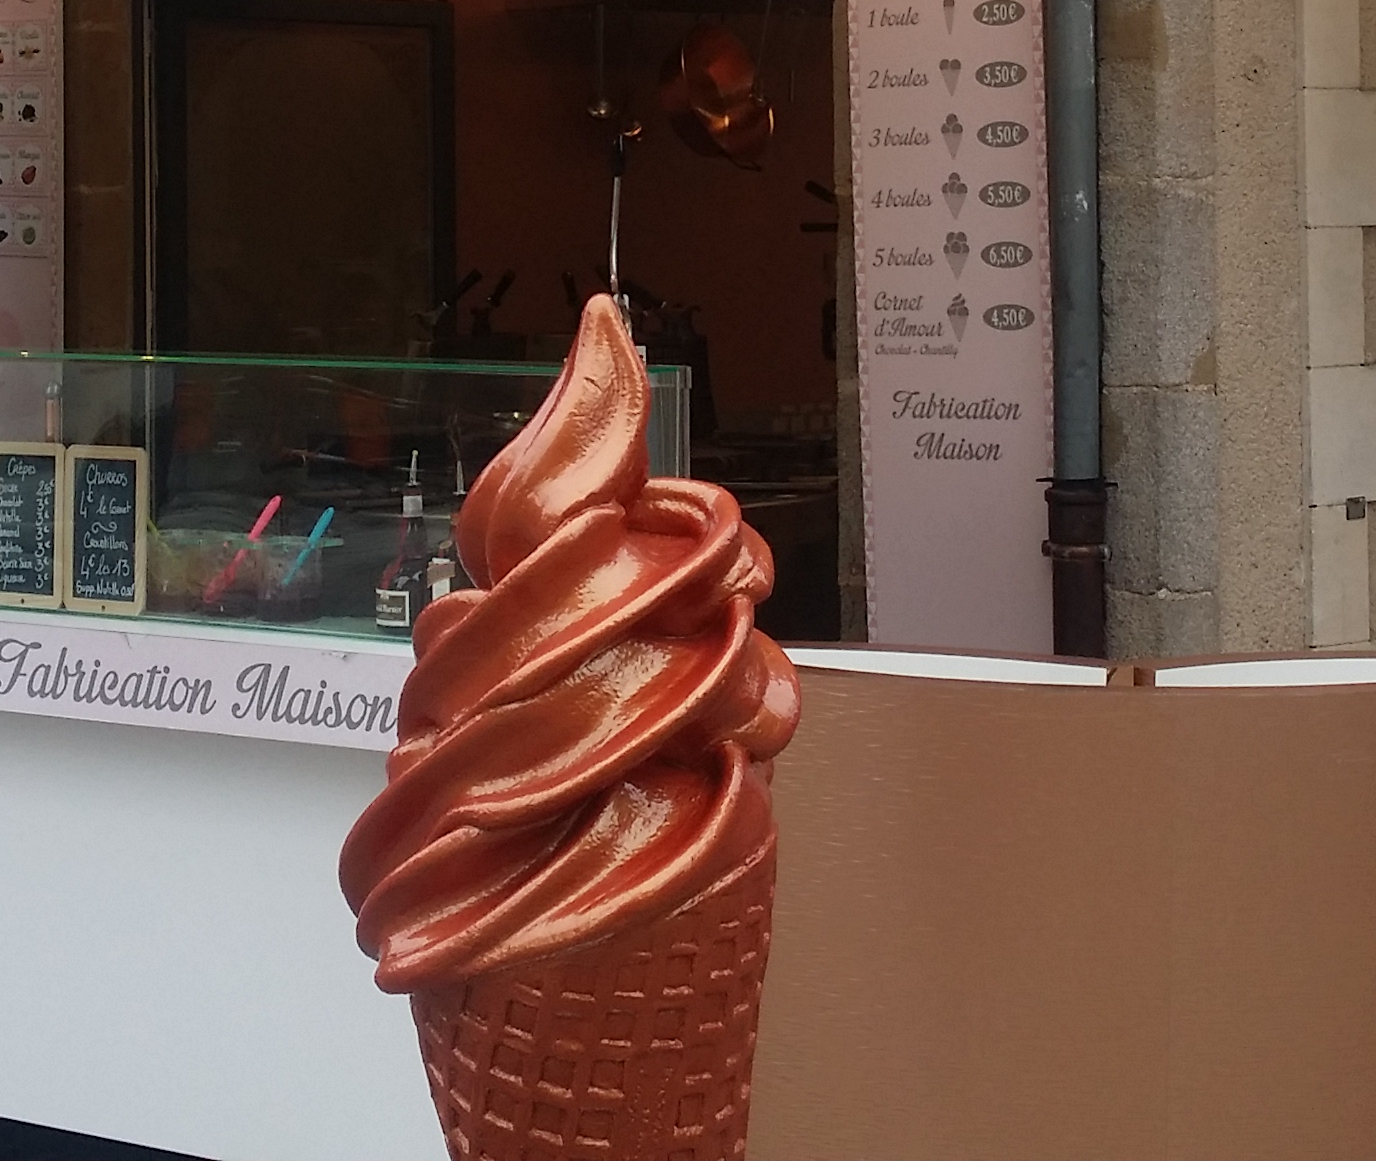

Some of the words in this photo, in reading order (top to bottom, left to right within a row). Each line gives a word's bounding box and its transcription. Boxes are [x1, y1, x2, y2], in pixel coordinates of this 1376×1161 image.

[868, 9, 876, 28] 1
[880, 6, 920, 28] boule
[981, 3, 1018, 23] 2,50€
[868, 71, 880, 90] 2
[881, 68, 929, 89] boules
[983, 64, 1019, 84] 3,50€
[869, 127, 882, 148] 3
[884, 126, 932, 147] boules
[985, 125, 1021, 145] 4,50€
[871, 189, 883, 209] 4
[885, 186, 933, 208] boules
[987, 184, 1023, 205] 5,50€
[873, 248, 885, 268] 5
[887, 246, 935, 268] boules
[989, 244, 1025, 265] 6,50€
[874, 290, 924, 312] Cornet
[874, 316, 945, 338] d'Amour
[990, 307, 1027, 327] 4,50€
[892, 389, 1022, 420] Fabrication
[913, 431, 1003, 461] Maison
[86, 463, 128, 487] Churros
[111, 558, 130, 577] 13
[231, 663, 398, 734] Maison
